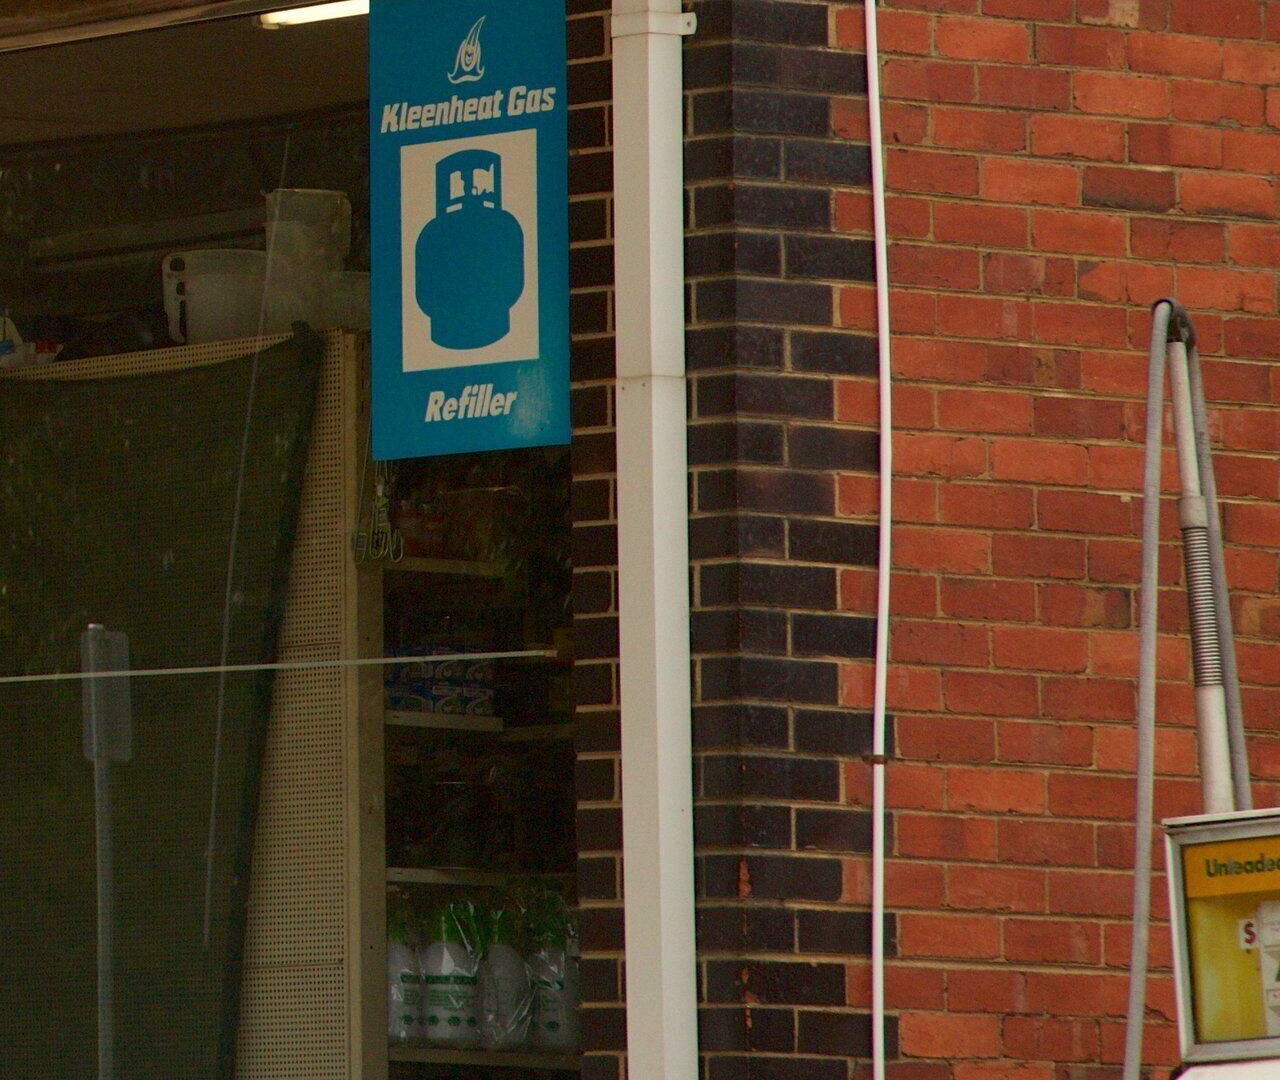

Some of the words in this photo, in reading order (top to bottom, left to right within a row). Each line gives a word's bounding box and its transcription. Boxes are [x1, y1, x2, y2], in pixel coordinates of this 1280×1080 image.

[380, 89, 502, 134] Kleenheat
[507, 85, 556, 118] Gas
[424, 383, 518, 423] Refiller
